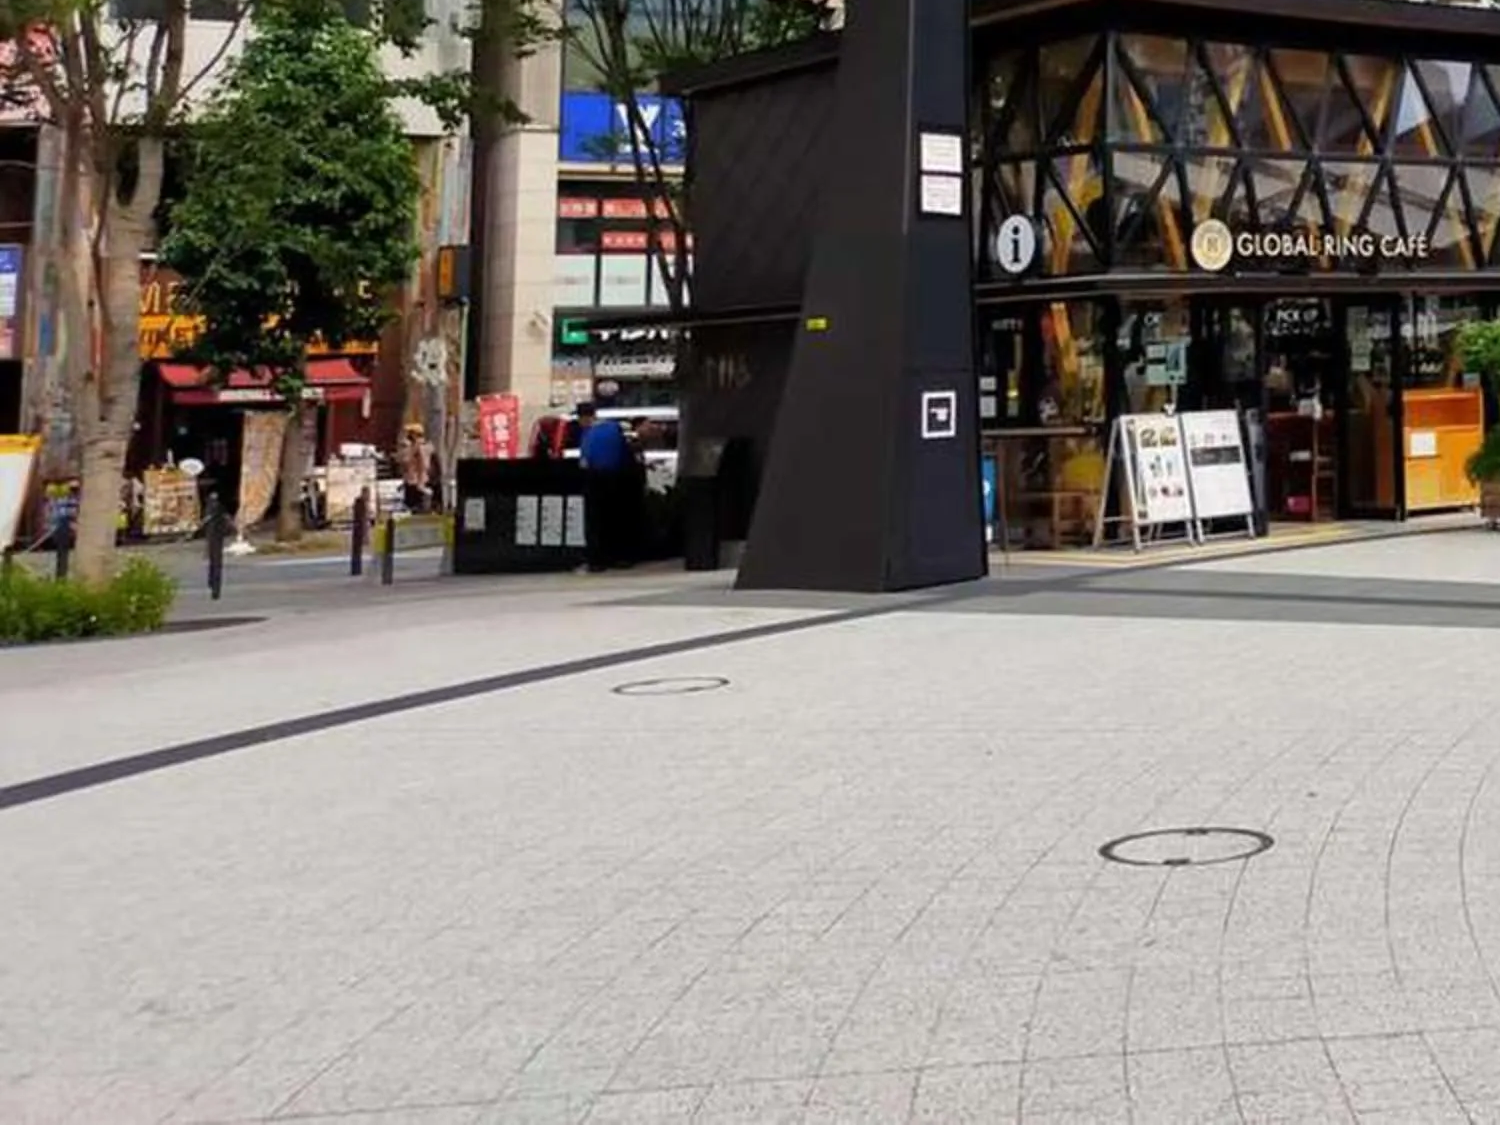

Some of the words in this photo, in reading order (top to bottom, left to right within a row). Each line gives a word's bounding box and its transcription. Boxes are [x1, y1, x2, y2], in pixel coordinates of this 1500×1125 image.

[1236, 231, 1319, 257] GLOBAL
[1323, 234, 1374, 258] RING
[1380, 231, 1428, 258] CAFÉ
